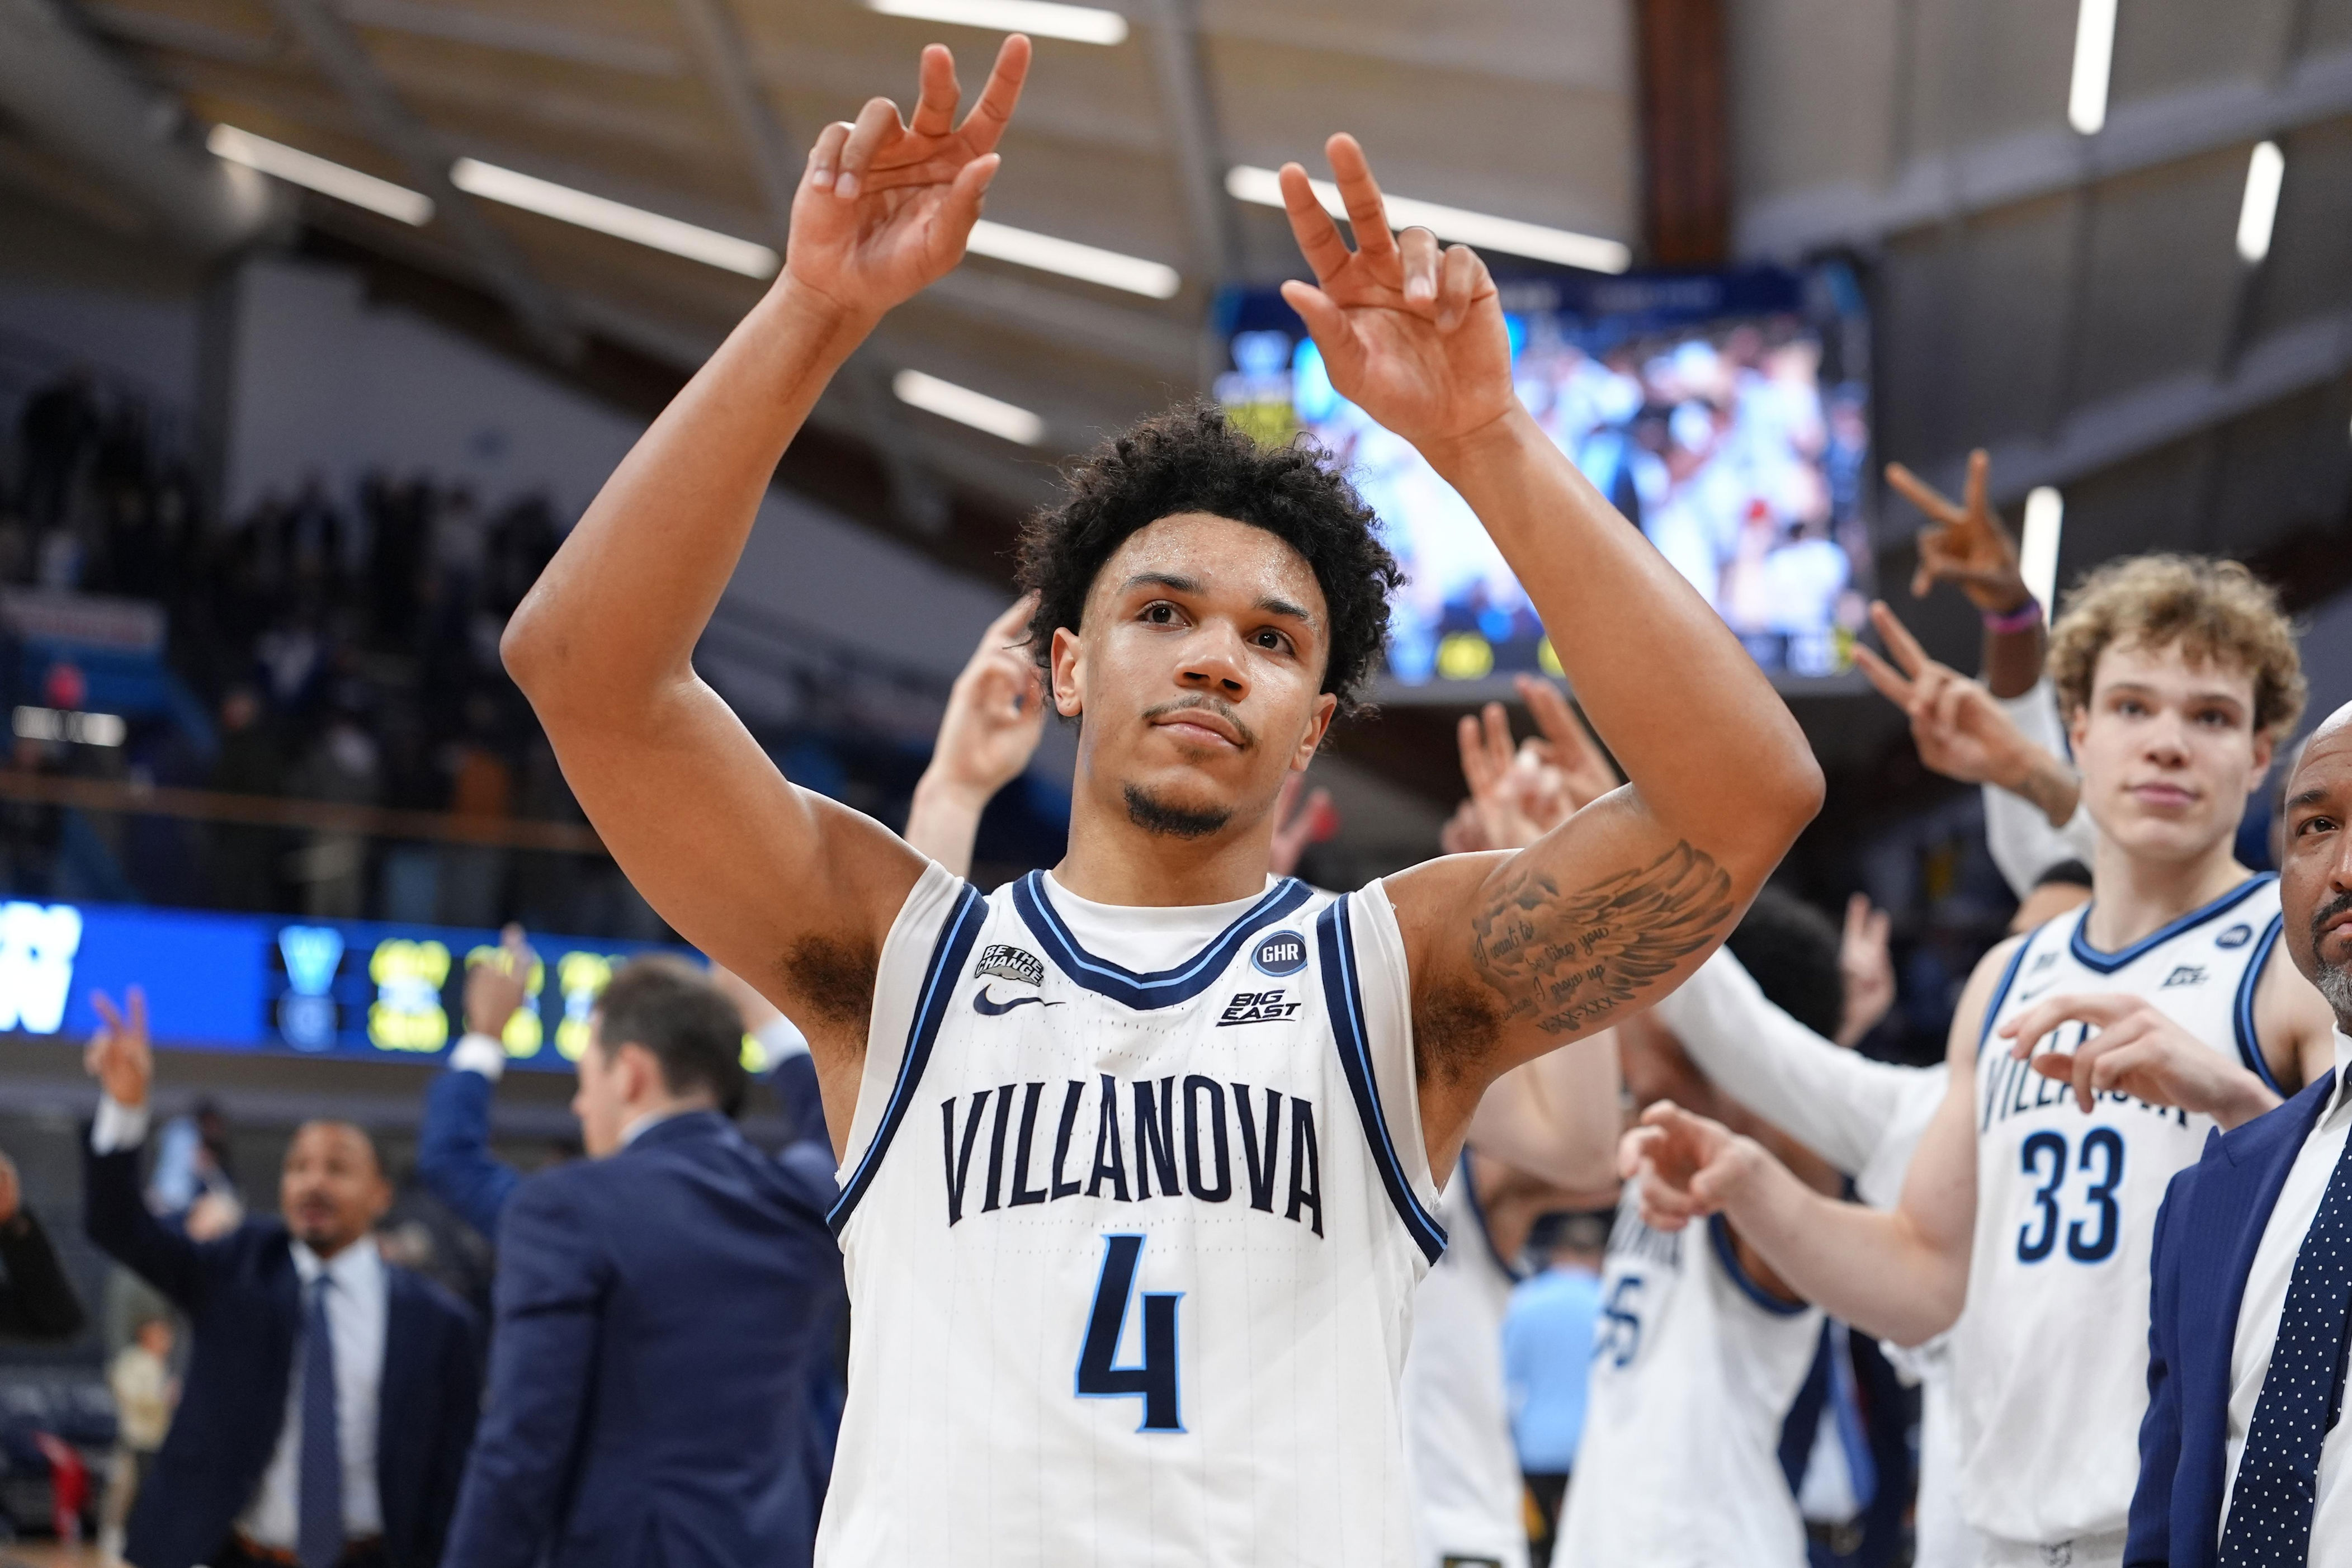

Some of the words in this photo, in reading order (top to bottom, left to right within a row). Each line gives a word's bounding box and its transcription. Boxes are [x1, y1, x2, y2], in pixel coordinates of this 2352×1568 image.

[983, 946, 1009, 959] BE
[1013, 948, 1043, 972] THE
[1262, 943, 1299, 963] GHR
[1490, 925, 1519, 960] want
[1518, 920, 1534, 941] to
[1526, 958, 1546, 971] be
[1578, 927, 1609, 957] you
[976, 956, 1043, 983] CHANGE
[1221, 1003, 1302, 1020] EAST
[1229, 989, 1286, 1007] BIG
[1502, 996, 1532, 1021] when
[1533, 976, 1546, 1002] I
[1550, 972, 1583, 1003] grow
[941, 1074, 1324, 1240] VILLANOVA
[2016, 1125, 2126, 1265] 33
[1074, 1233, 1189, 1434] 4
